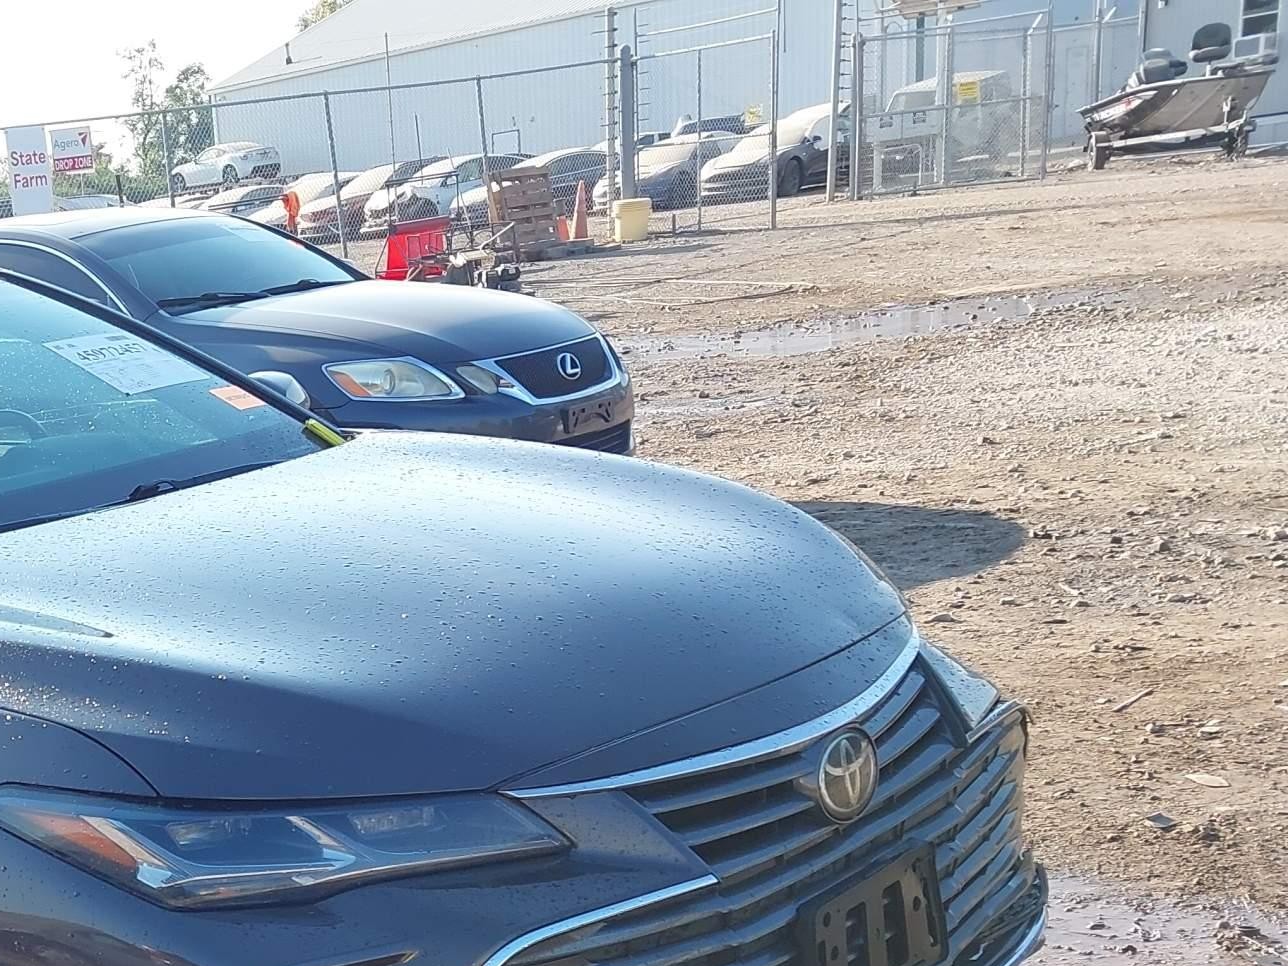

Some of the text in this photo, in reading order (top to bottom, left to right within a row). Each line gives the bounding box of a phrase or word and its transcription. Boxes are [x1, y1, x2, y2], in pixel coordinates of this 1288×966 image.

[54, 139, 79, 151] Agero
[11, 150, 46, 166] State
[55, 156, 92, 171] DROP ZONE
[14, 174, 48, 189] Farm
[76, 342, 146, 362] 45972457
